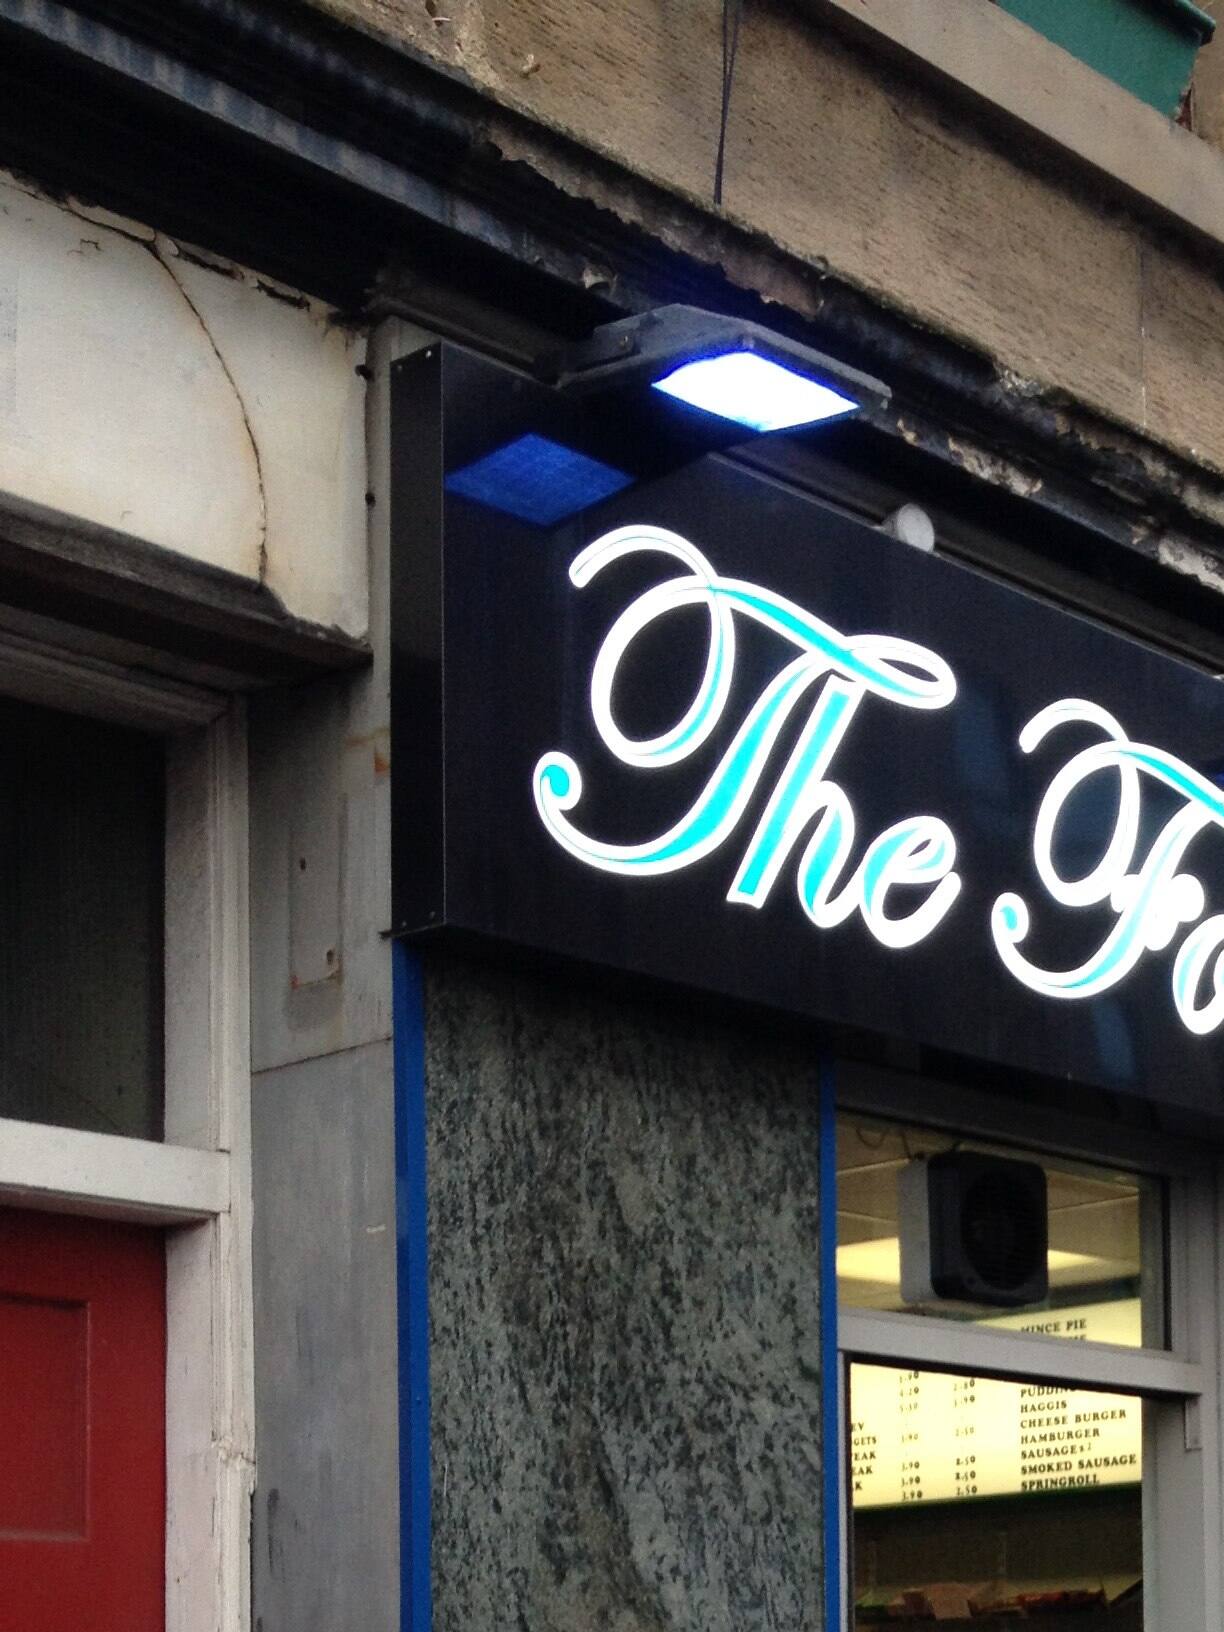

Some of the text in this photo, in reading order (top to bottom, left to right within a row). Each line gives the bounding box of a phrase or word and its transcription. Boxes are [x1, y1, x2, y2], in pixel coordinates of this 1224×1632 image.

[533, 524, 962, 948] The
[1066, 1318, 1088, 1331] PIE
[1020, 1400, 1068, 1413] HAGGIS
[1020, 1416, 1068, 1429] CHEESE
[1074, 1409, 1127, 1423] BURGER
[1020, 1428, 1100, 1444] HAMBURGER
[1021, 1461, 1073, 1475] SMOKED
[1078, 1454, 1137, 1469] SAUSAGE
[1020, 1474, 1101, 1491] SPRINGROLL
